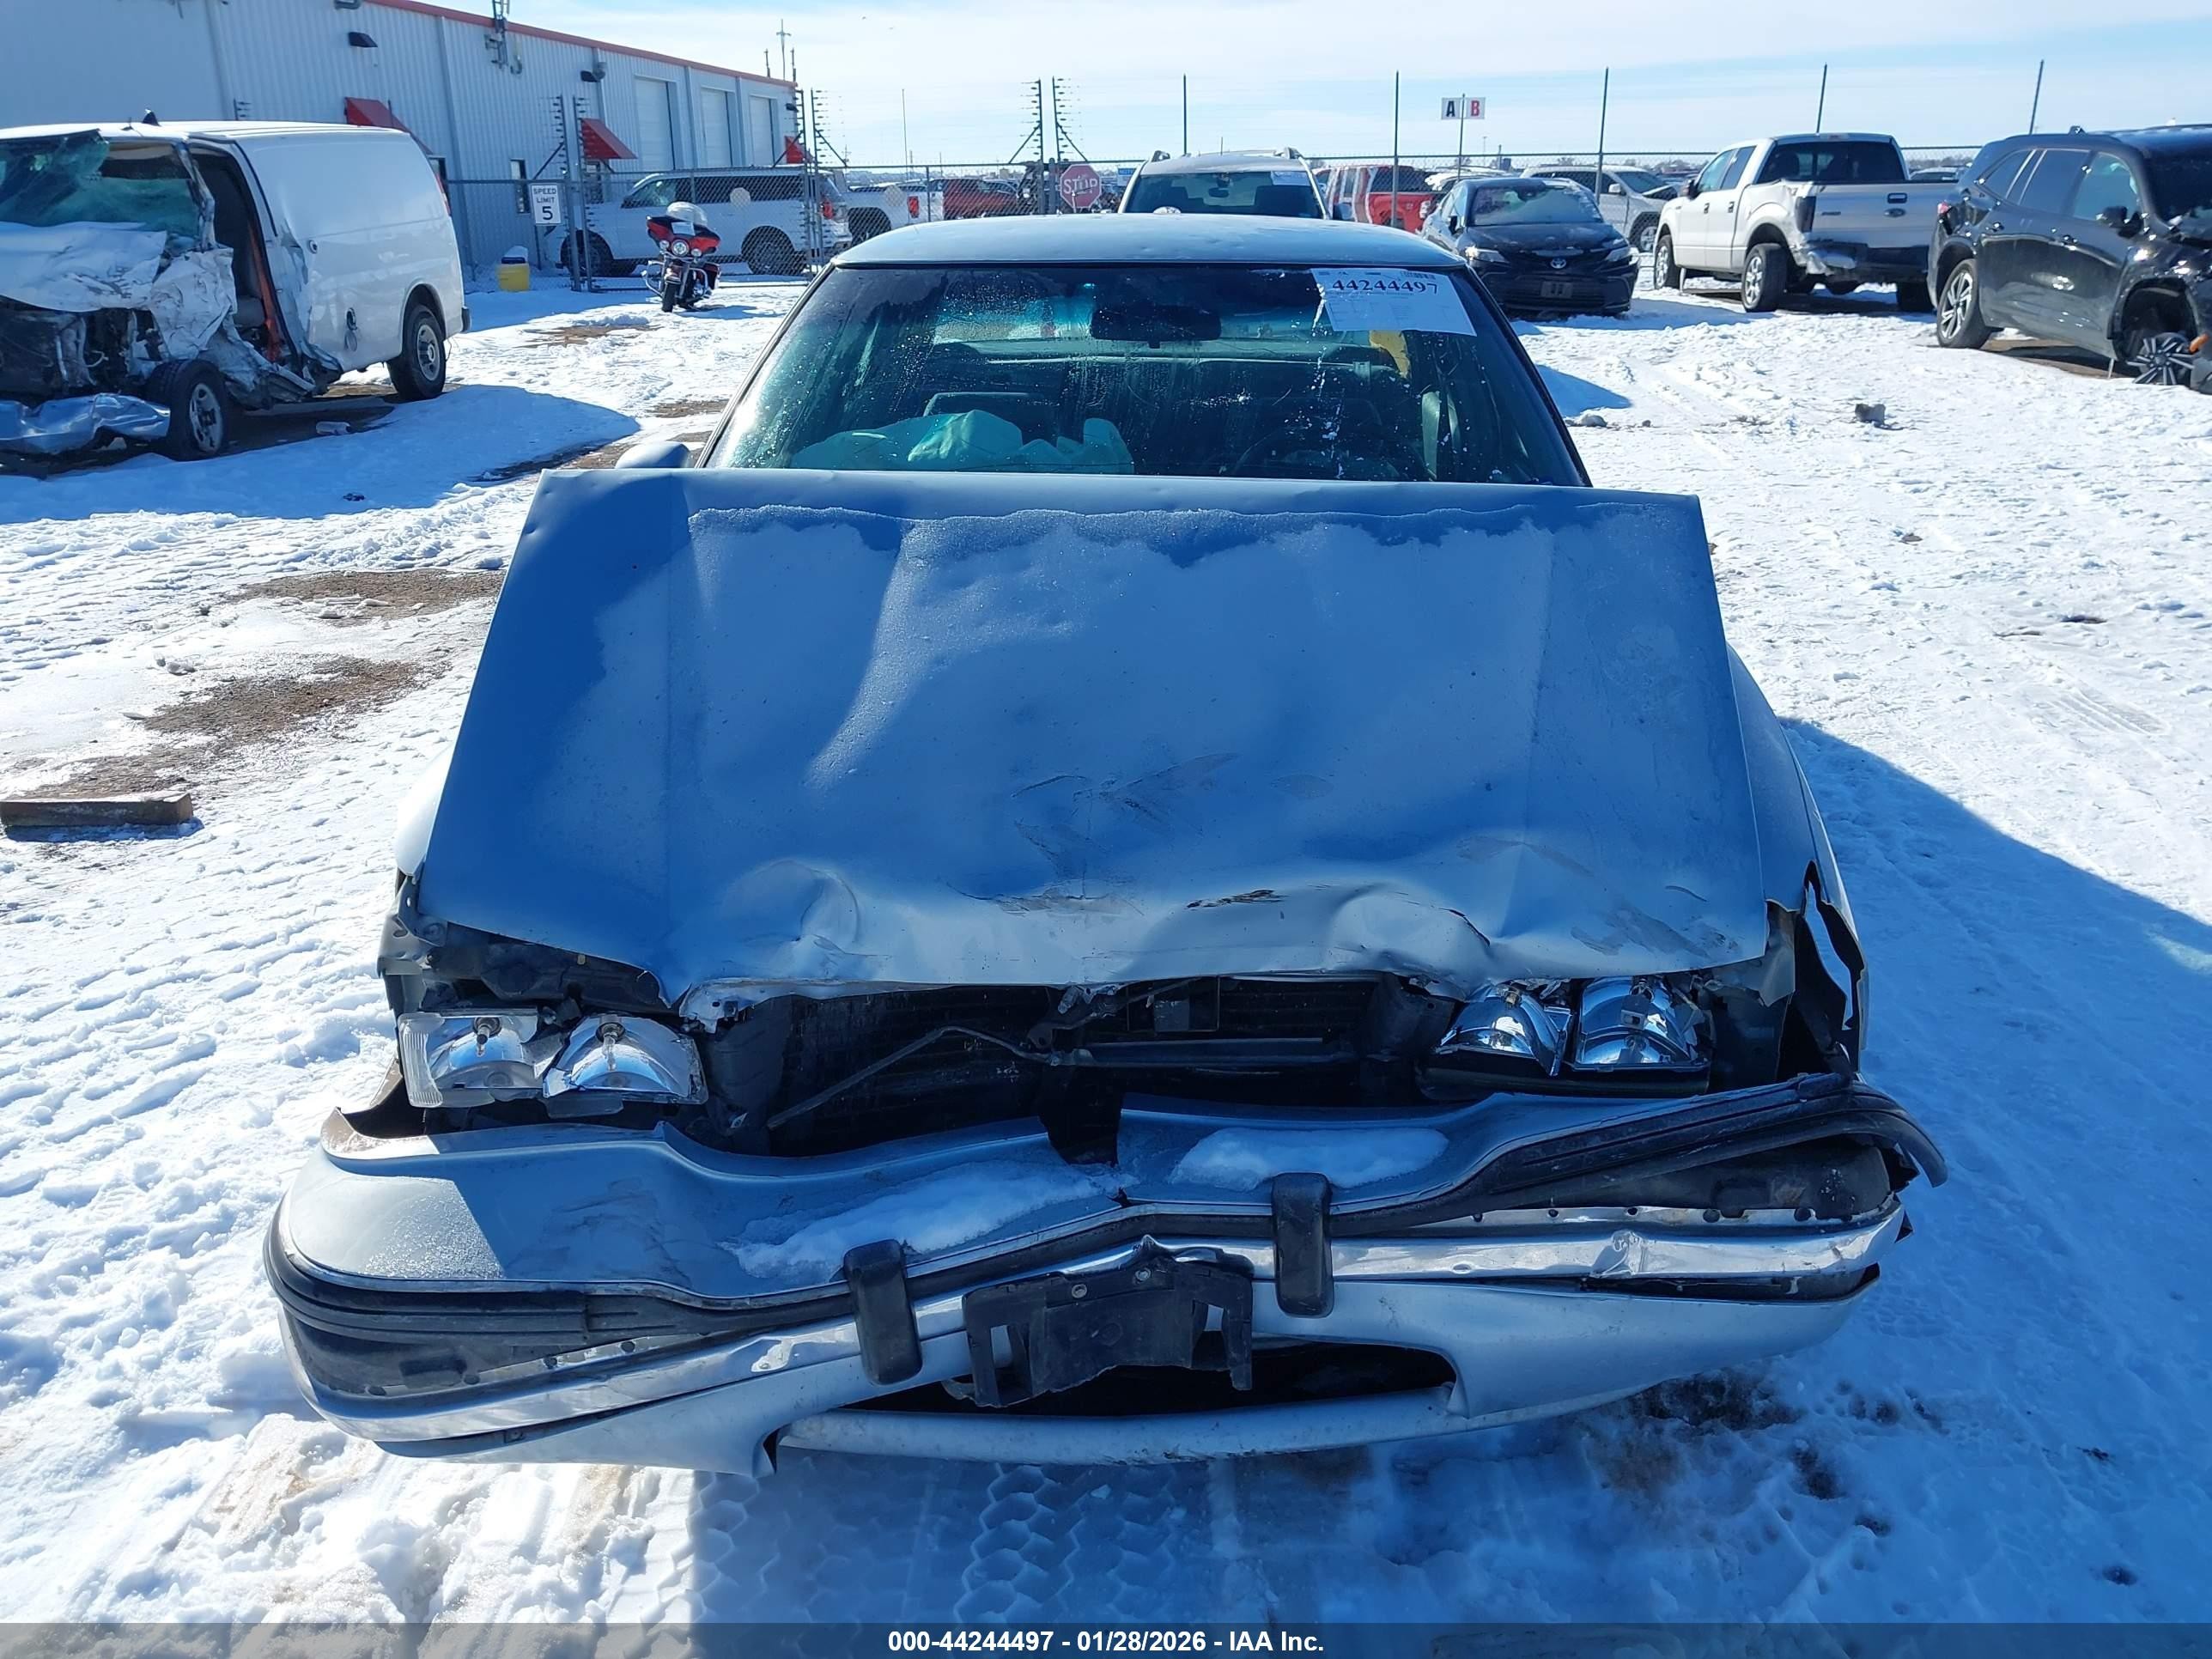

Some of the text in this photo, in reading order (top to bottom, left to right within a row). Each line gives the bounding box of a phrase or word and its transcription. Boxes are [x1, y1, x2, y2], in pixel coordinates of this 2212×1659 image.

[1445, 100, 1455, 117] A
[1470, 100, 1480, 117] B
[1063, 178, 1098, 194] STOP
[542, 206, 553, 221] 5
[1332, 279, 1438, 295] 44244497
